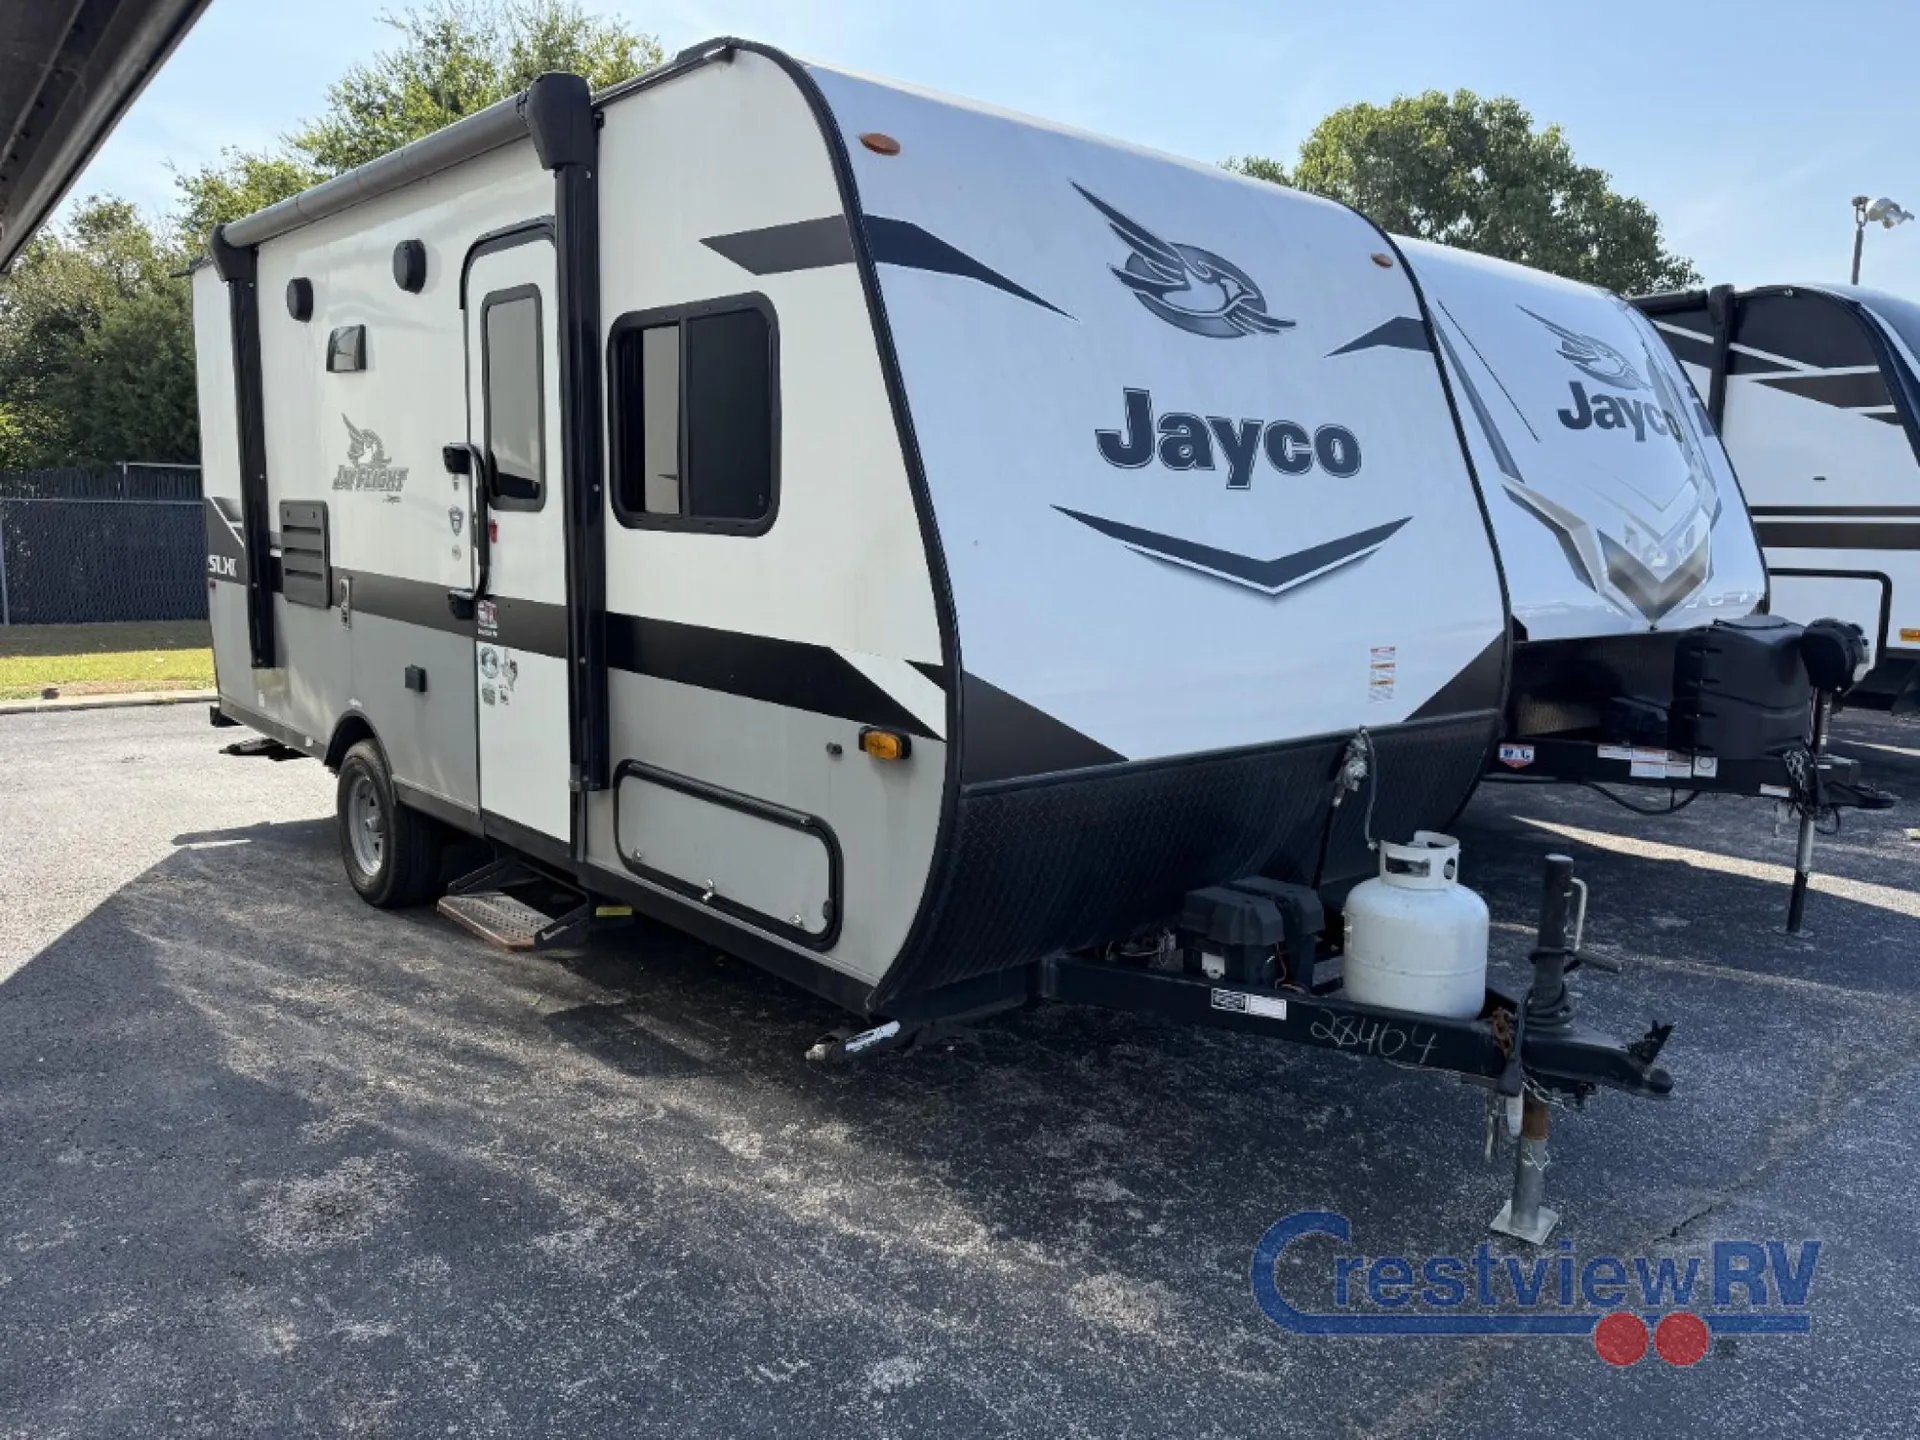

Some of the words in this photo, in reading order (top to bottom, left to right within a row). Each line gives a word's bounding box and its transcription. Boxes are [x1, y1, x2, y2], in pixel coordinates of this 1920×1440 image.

[1095, 386, 1362, 490] Jayco
[1557, 380, 1683, 442] Jayco
[1310, 1008, 1440, 1065] 28404
